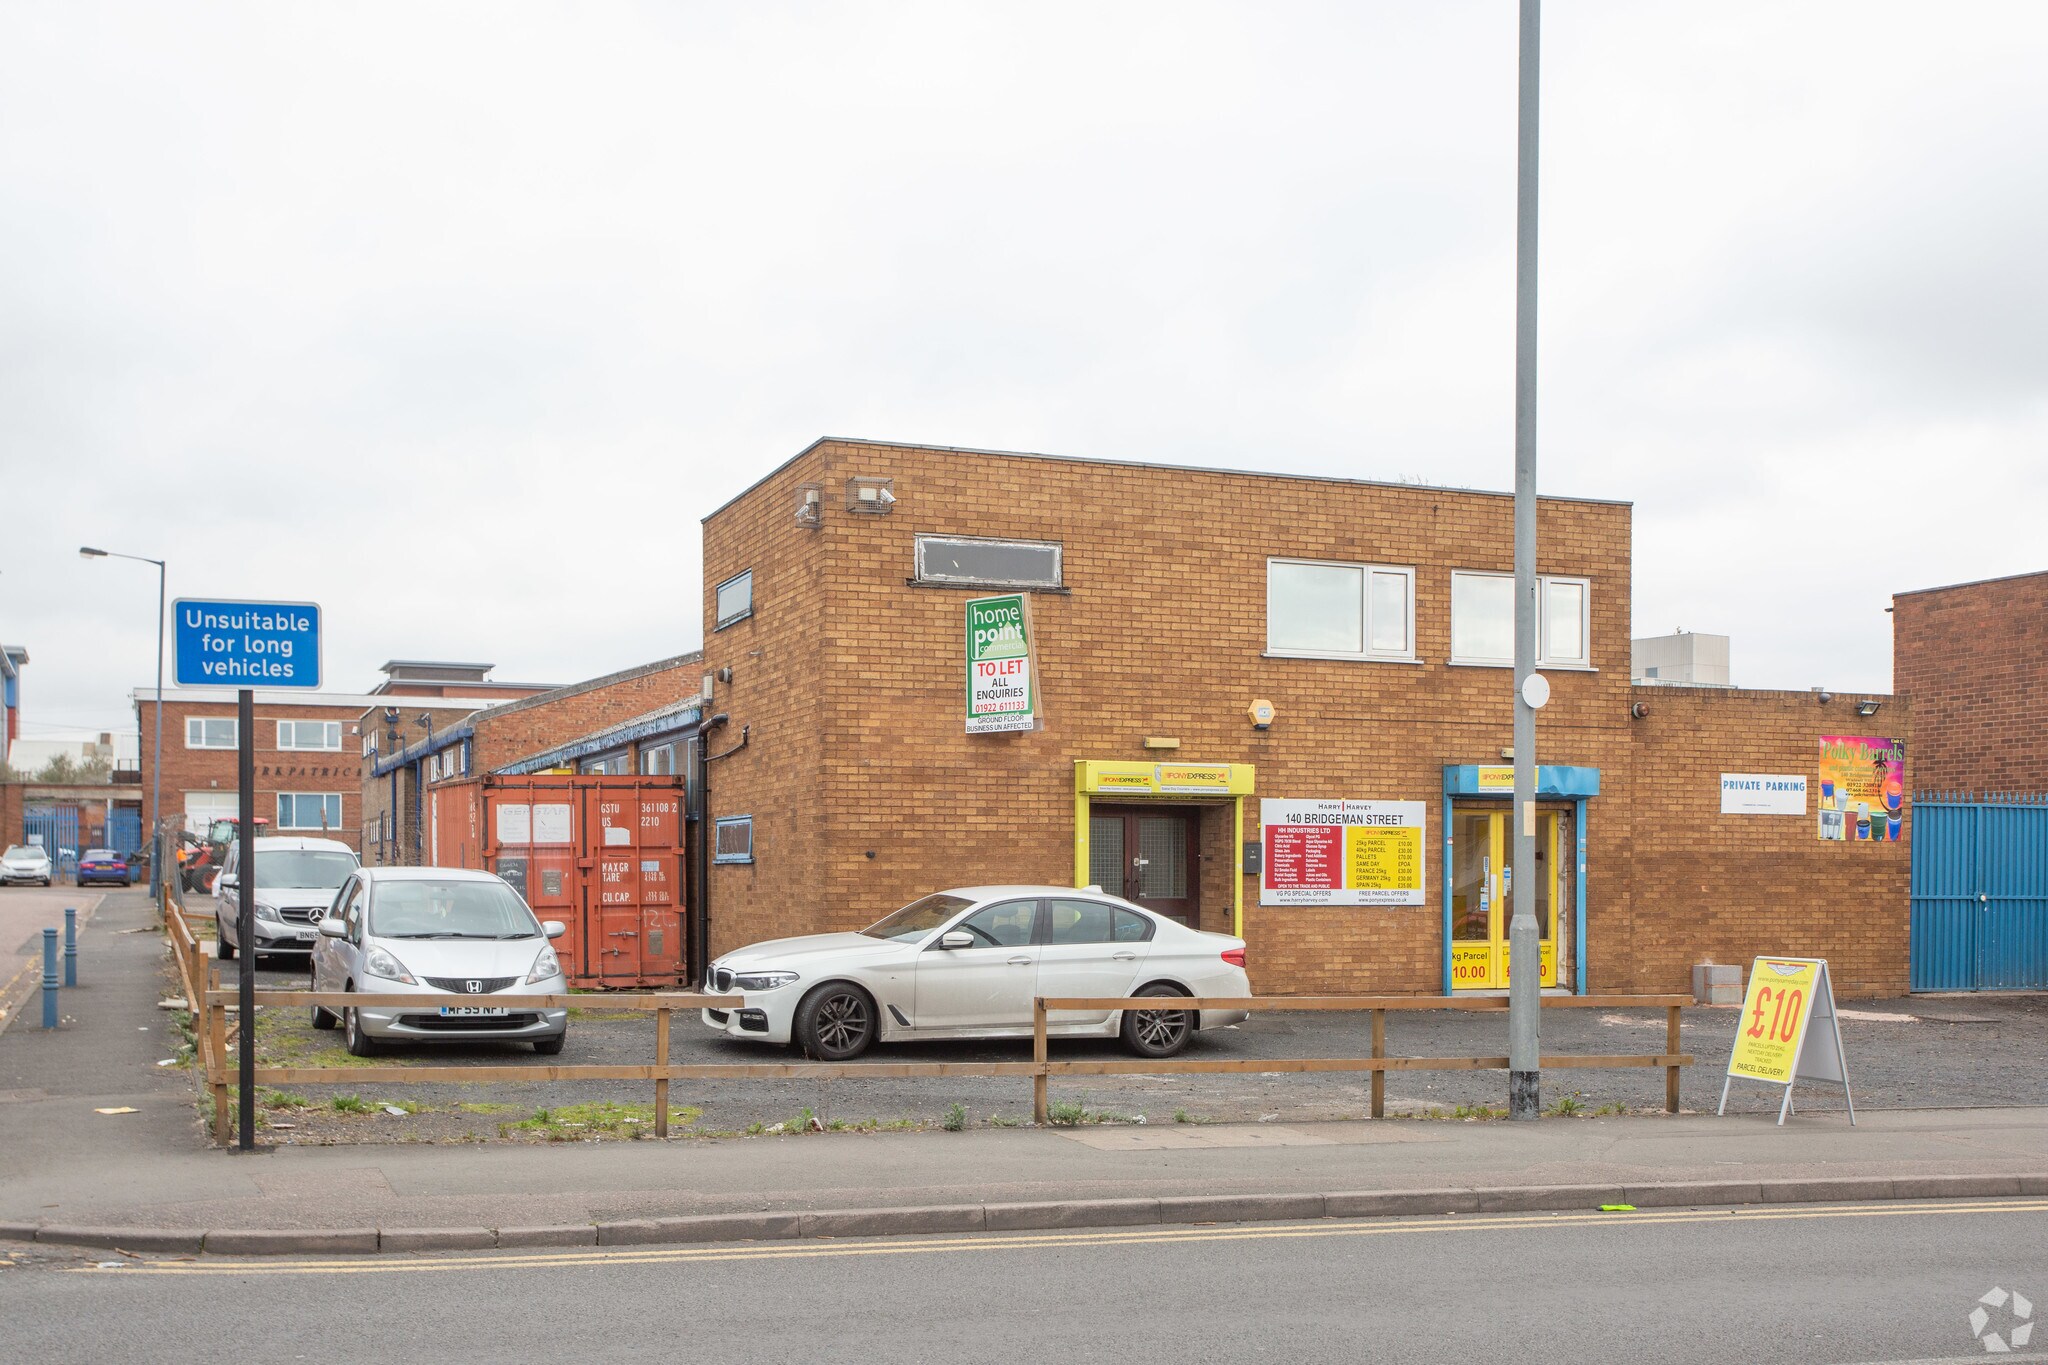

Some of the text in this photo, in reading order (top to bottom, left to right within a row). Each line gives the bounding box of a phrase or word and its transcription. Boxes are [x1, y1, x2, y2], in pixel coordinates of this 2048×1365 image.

[186, 609, 310, 631] Unsuitable
[974, 606, 1020, 625] home
[202, 633, 293, 658] for long
[980, 642, 1024, 653] commercial
[202, 658, 294, 677] vehicles
[978, 660, 1023, 677] TO LET
[992, 678, 1008, 688] ALL
[976, 688, 1024, 700] ENQUIRIES
[975, 701, 1025, 713] 01922 611133
[1823, 742, 1903, 764] Polky Barrels
[1724, 780, 1805, 791] PRIVATE PARKING
[600, 803, 677, 813] GSTU 361108 2
[602, 817, 659, 826] US 2210
[1286, 813, 1404, 825] 140 BRIDGEMAN STREET
[602, 873, 620, 882] TARE
[1453, 966, 1485, 978] 10.00
[1746, 986, 1802, 1042] £10
[1737, 1063, 1784, 1076] PARCEL DELIVERY
